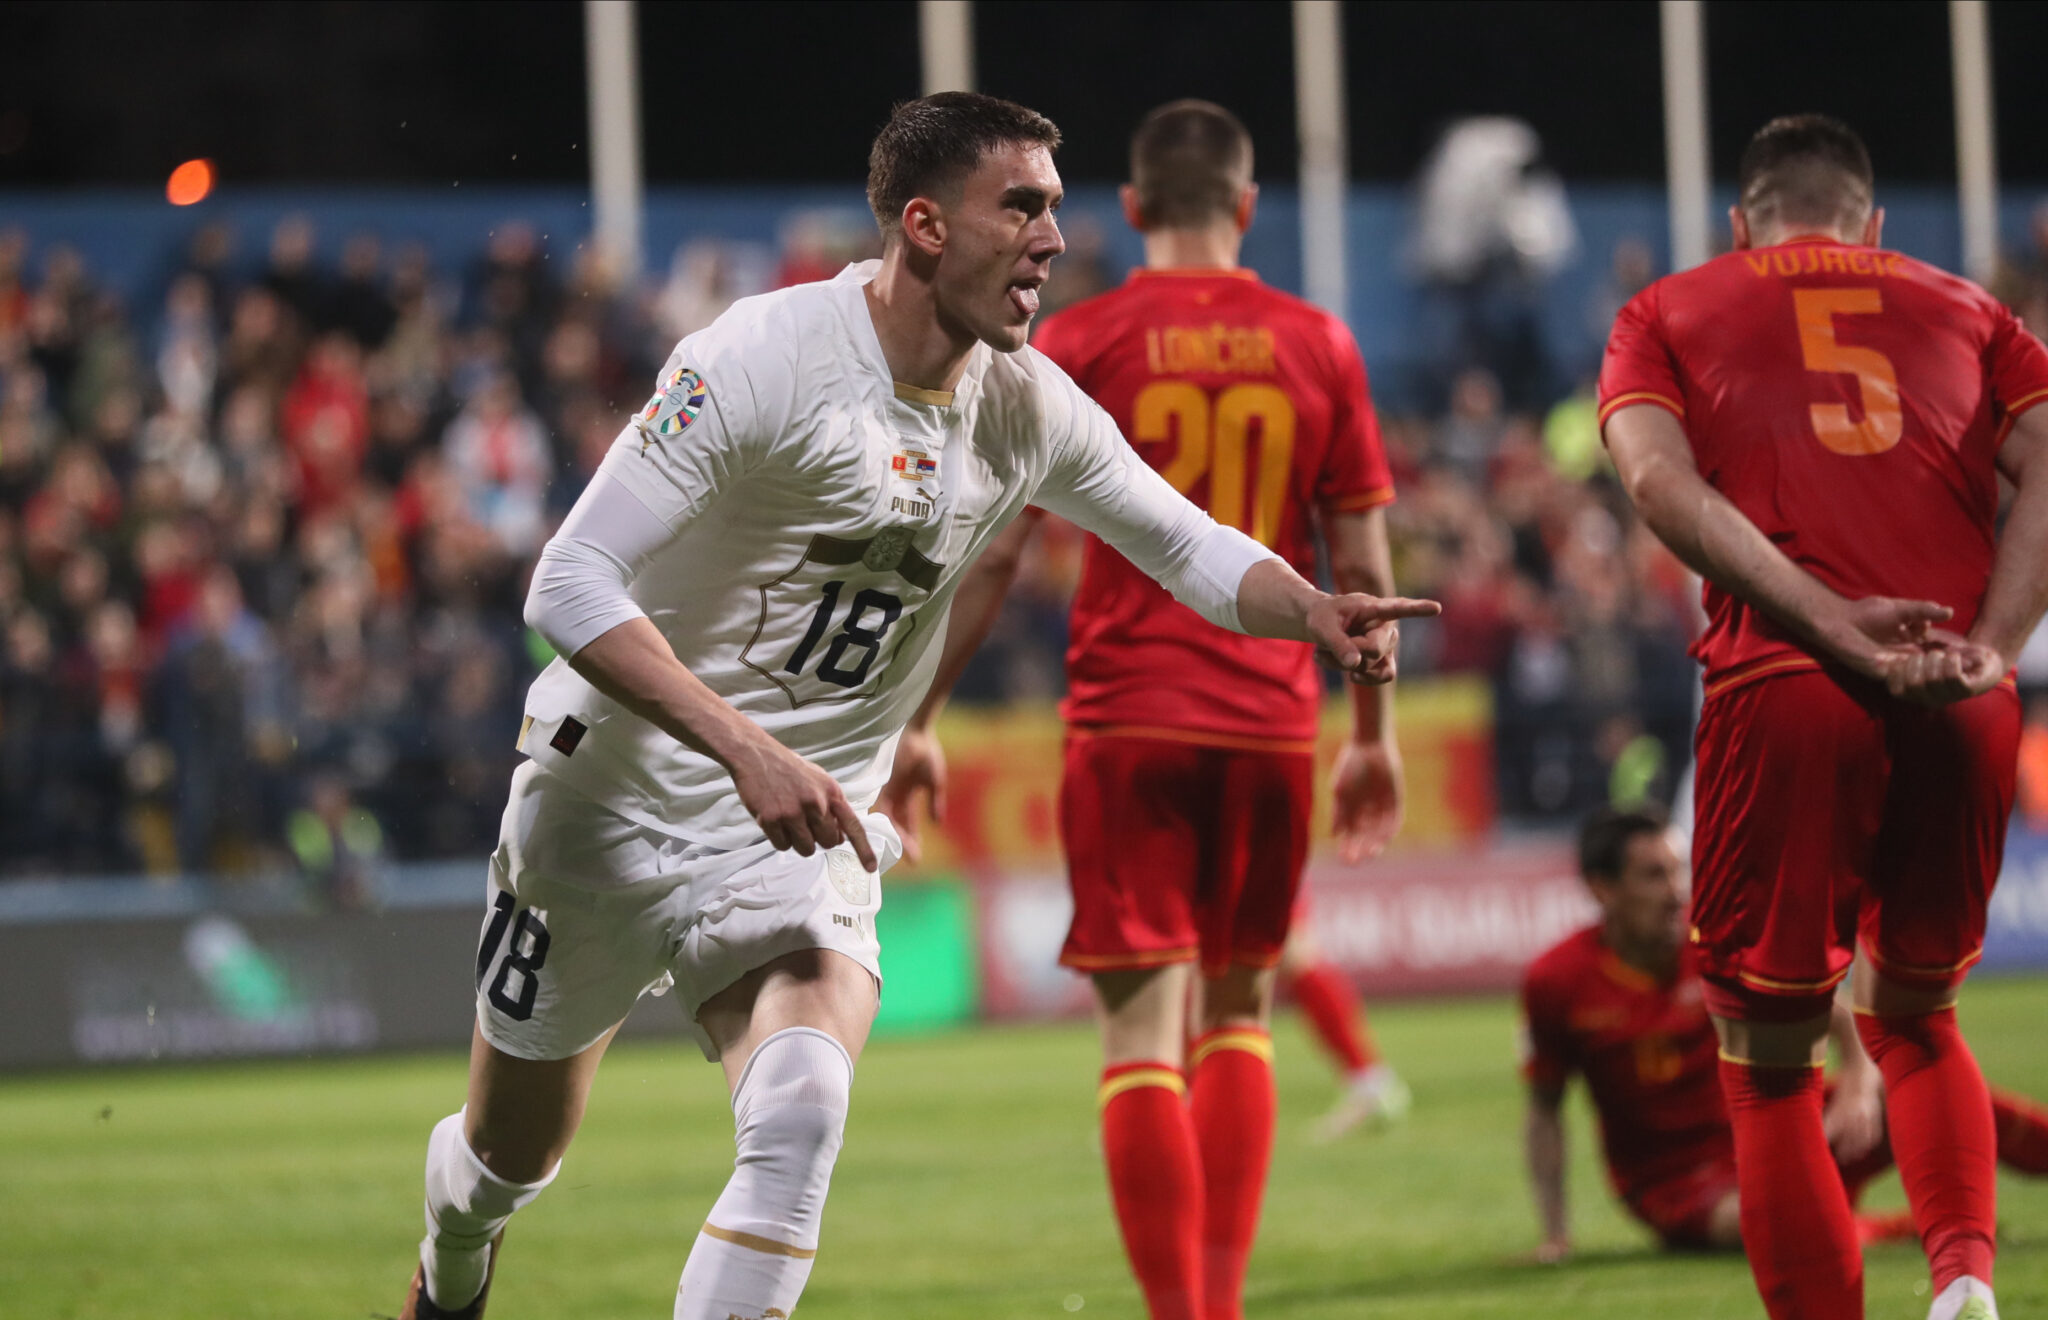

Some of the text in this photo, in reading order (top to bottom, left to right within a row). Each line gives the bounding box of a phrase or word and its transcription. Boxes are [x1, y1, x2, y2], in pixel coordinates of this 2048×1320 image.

[1792, 288, 1904, 456] 5
[891, 496, 930, 519] PUMA
[1133, 380, 1296, 550] 20
[784, 580, 903, 688] 18
[476, 890, 551, 1022] 18
[832, 913, 853, 928] PU
